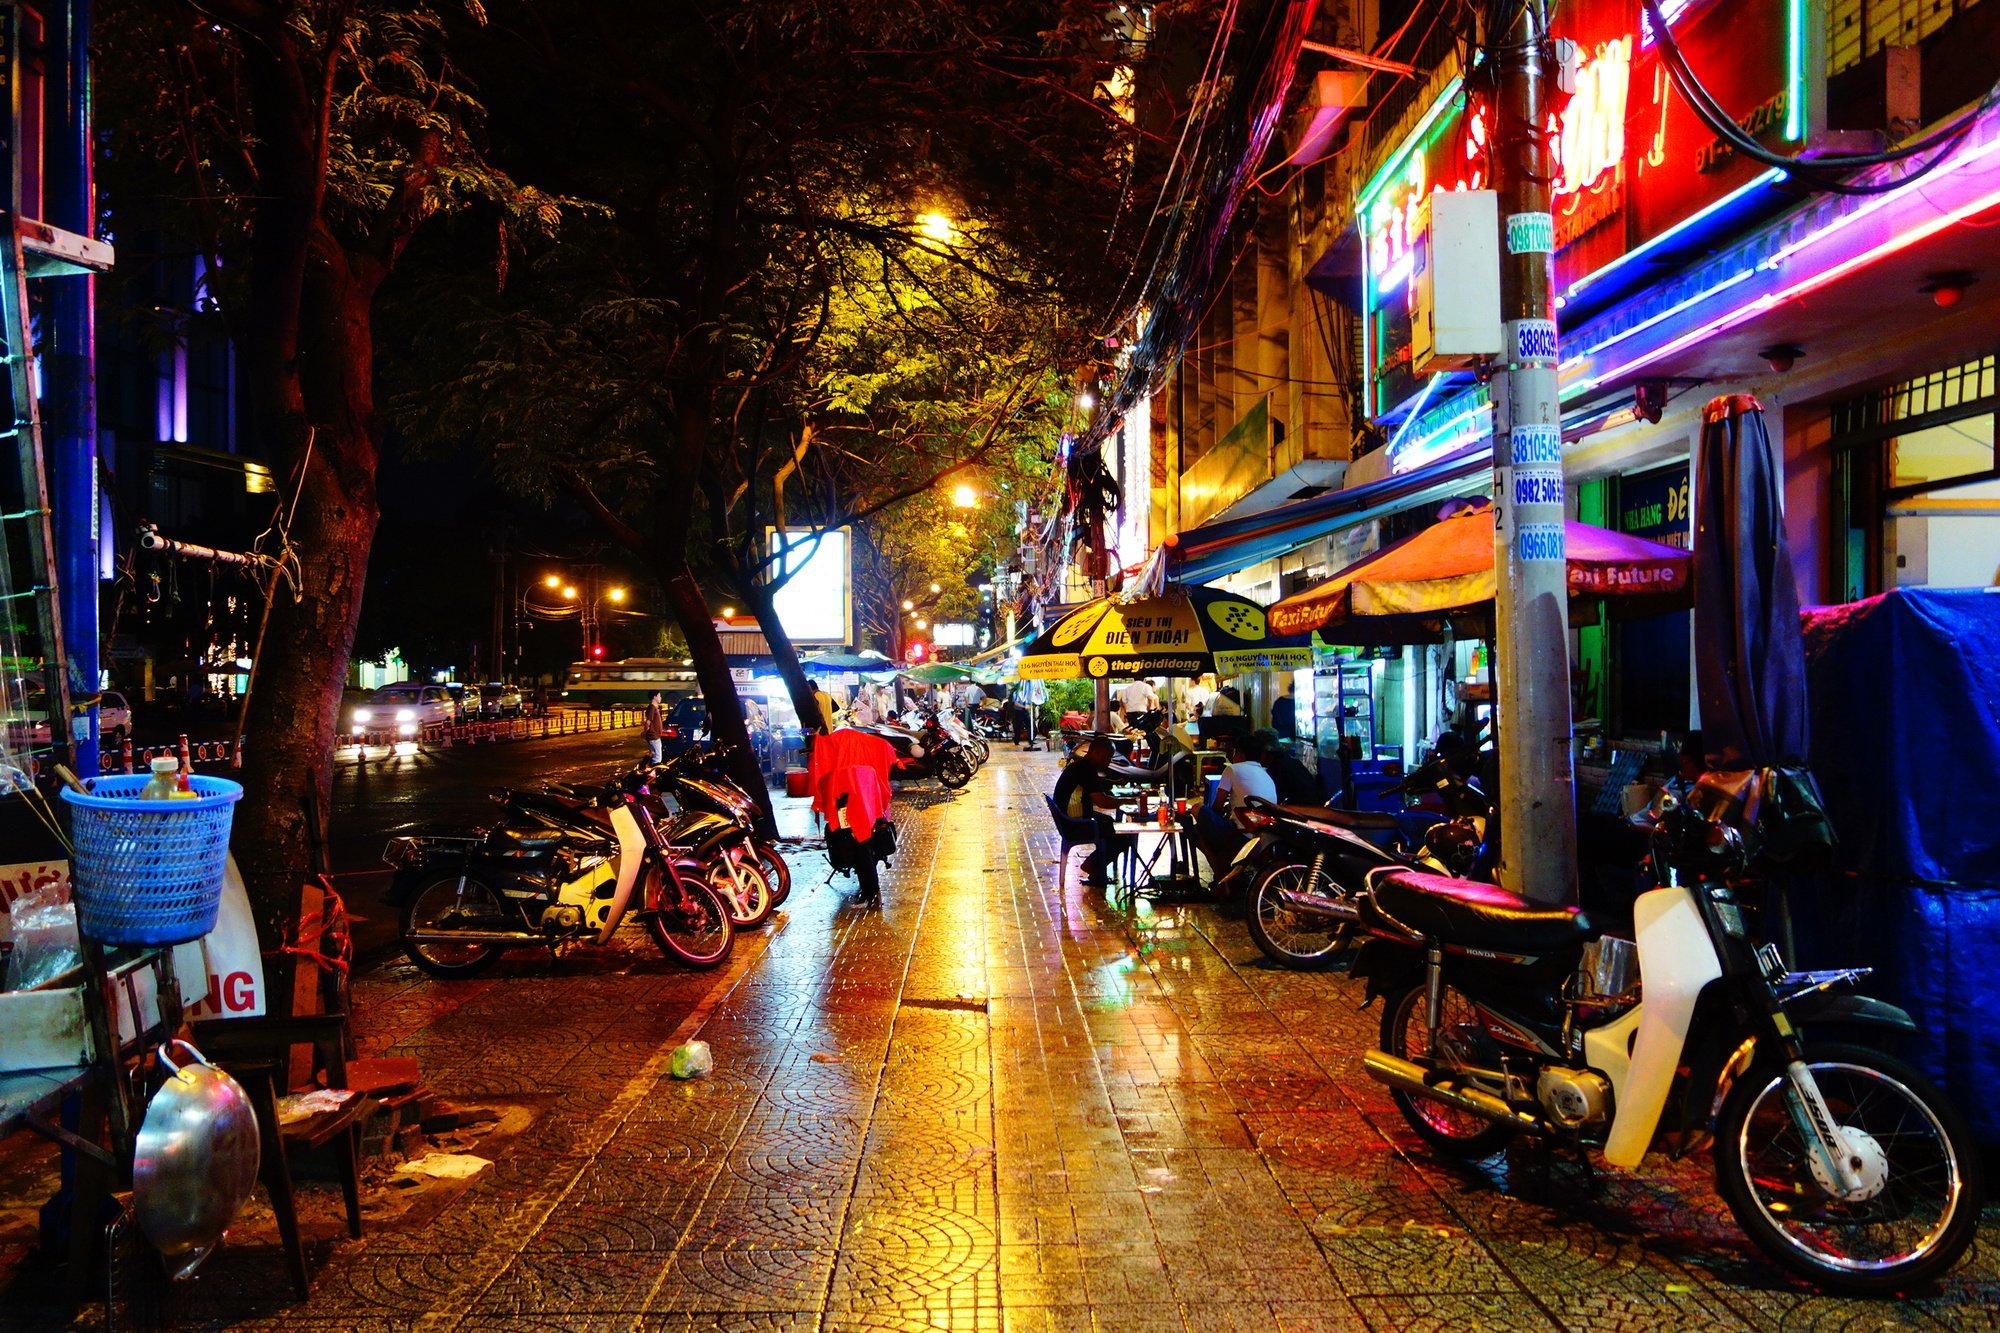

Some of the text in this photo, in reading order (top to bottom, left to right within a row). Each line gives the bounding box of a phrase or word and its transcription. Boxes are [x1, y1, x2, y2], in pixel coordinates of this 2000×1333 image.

[1568, 566, 1600, 585] axi
[1126, 616, 1173, 629] SIÊU THỊ
[1272, 608, 1300, 627] Taxi
[1105, 629, 1189, 647] ĐIỆN THOẠI
[1111, 658, 1200, 673] thegioididong
[1466, 948, 1497, 959] HONDA
[1489, 1023, 1526, 1042] Dream
